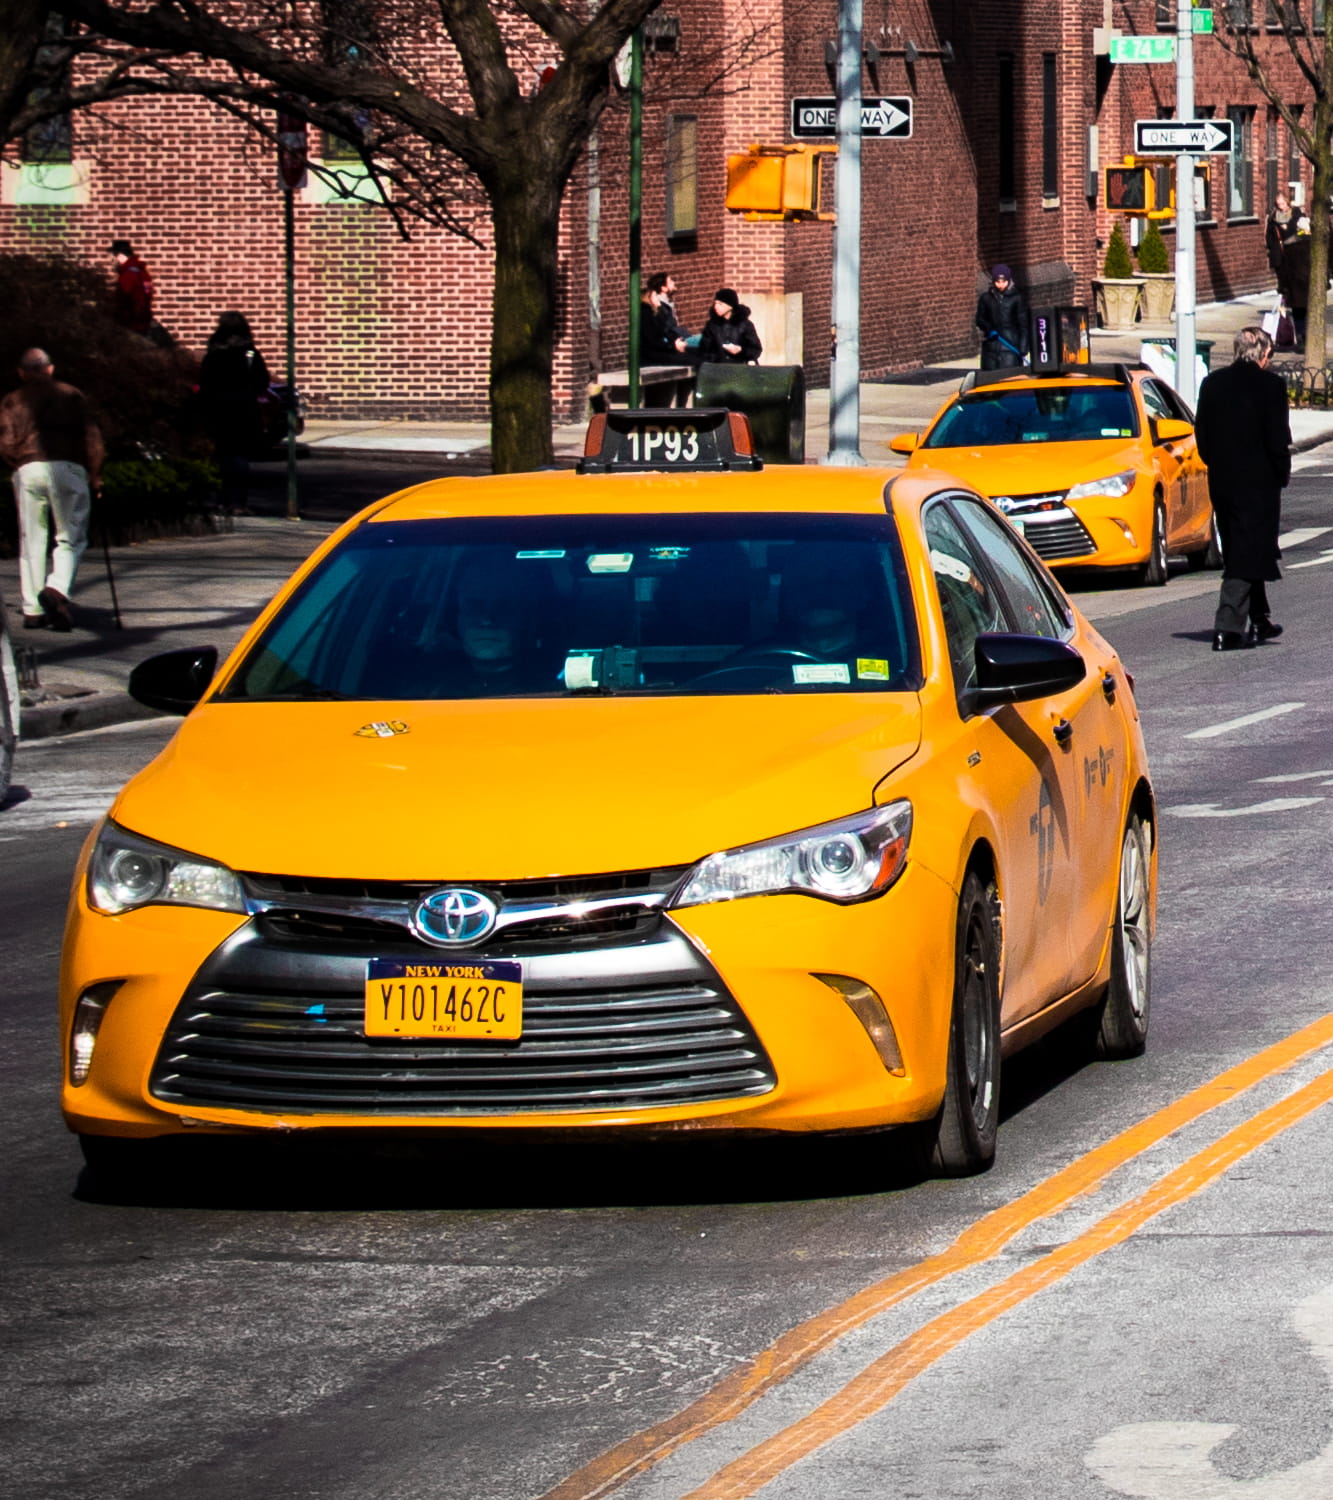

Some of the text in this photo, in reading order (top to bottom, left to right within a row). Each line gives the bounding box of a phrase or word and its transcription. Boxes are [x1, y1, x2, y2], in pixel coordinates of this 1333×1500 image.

[1117, 40, 1126, 58] E
[1133, 40, 1151, 58] 74
[803, 110, 836, 125] ONE
[1150, 131, 1217, 143] ONE WAY
[627, 425, 699, 462] 1P93
[405, 965, 485, 979] NEW YORK
[381, 984, 506, 1023] Y101462C
[432, 1025, 457, 1033] TAXI
